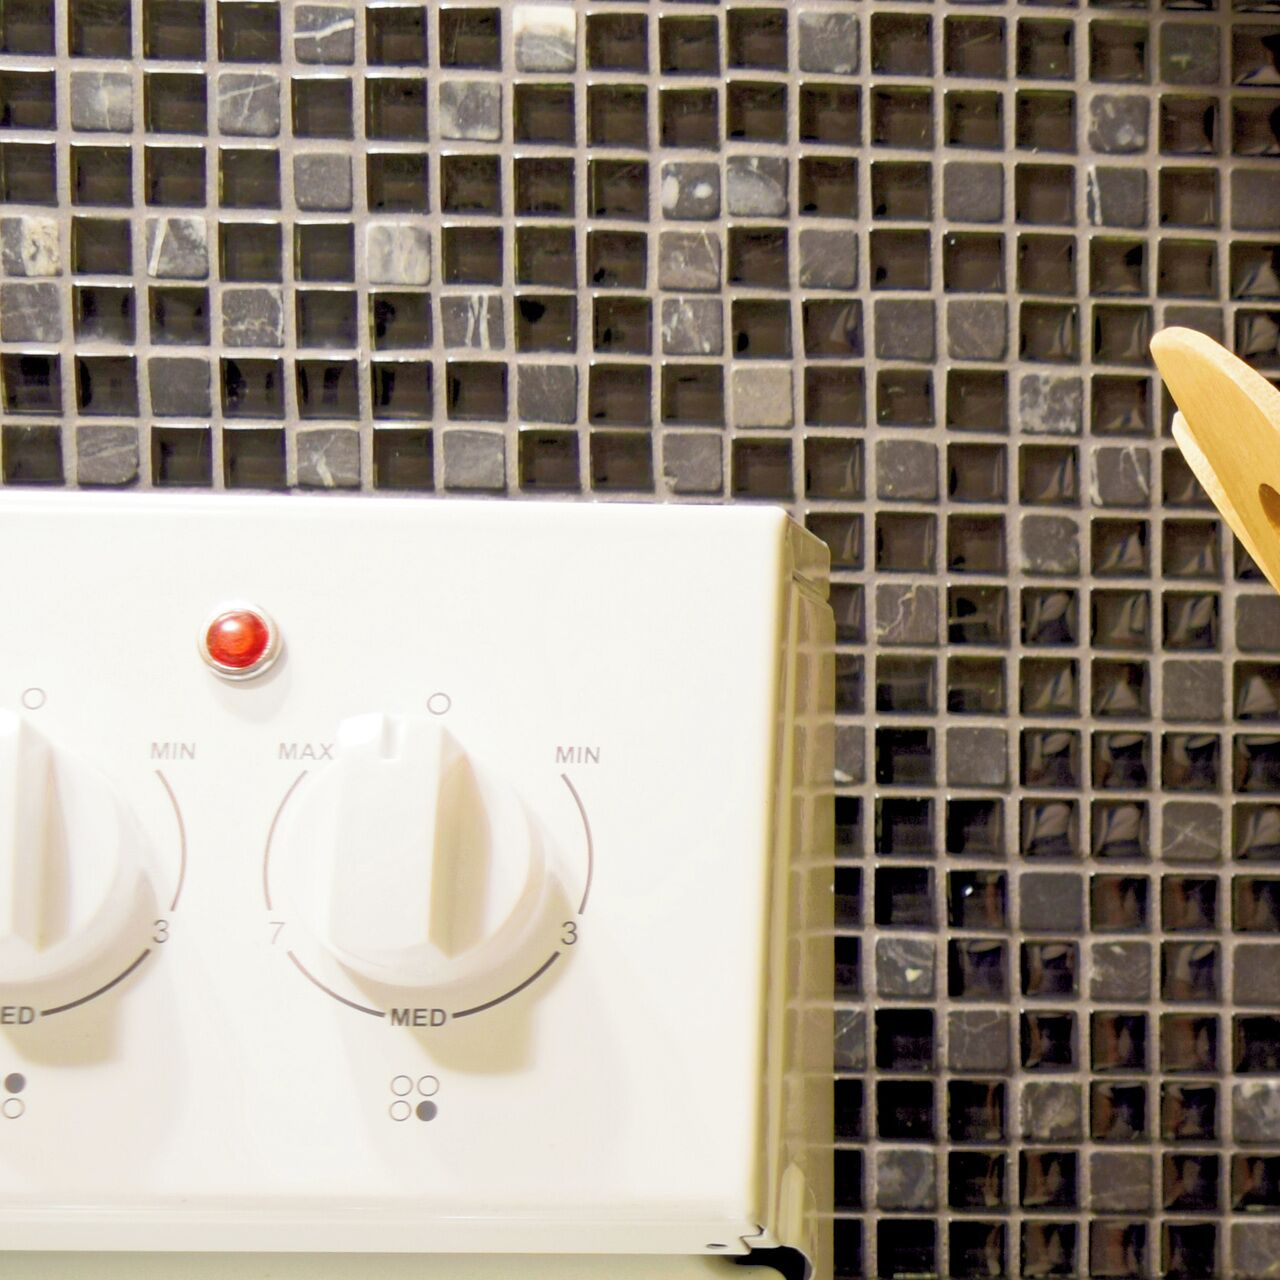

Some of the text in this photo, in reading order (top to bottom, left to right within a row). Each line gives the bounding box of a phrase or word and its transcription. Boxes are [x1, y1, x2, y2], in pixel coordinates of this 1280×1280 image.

[150, 742, 196, 761] MIN
[278, 742, 335, 761] MAX
[555, 745, 601, 764] MIN
[152, 919, 170, 944] 3
[268, 921, 286, 945] 7
[560, 920, 579, 946] 3
[0, 1005, 36, 1025] ED
[390, 1007, 448, 1028] MED
